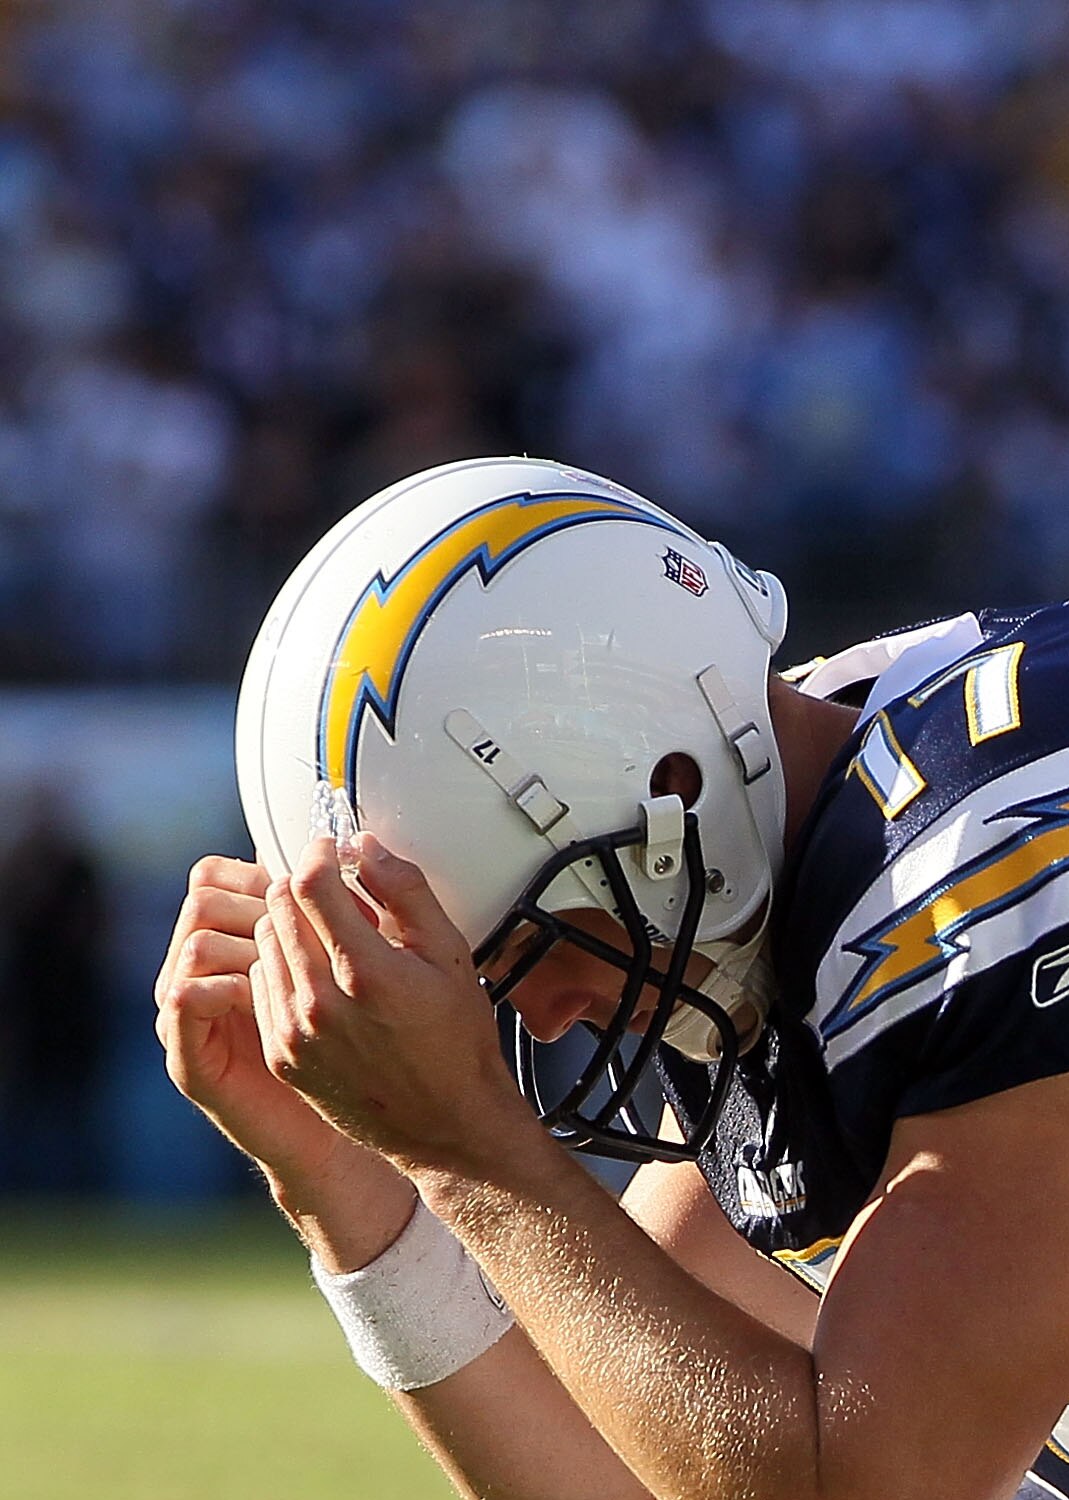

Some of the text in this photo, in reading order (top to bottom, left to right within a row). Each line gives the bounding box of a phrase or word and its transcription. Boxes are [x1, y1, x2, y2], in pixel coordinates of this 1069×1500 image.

[681, 562, 704, 594] NFL
[846, 641, 1026, 821] 17
[472, 739, 501, 765] 17
